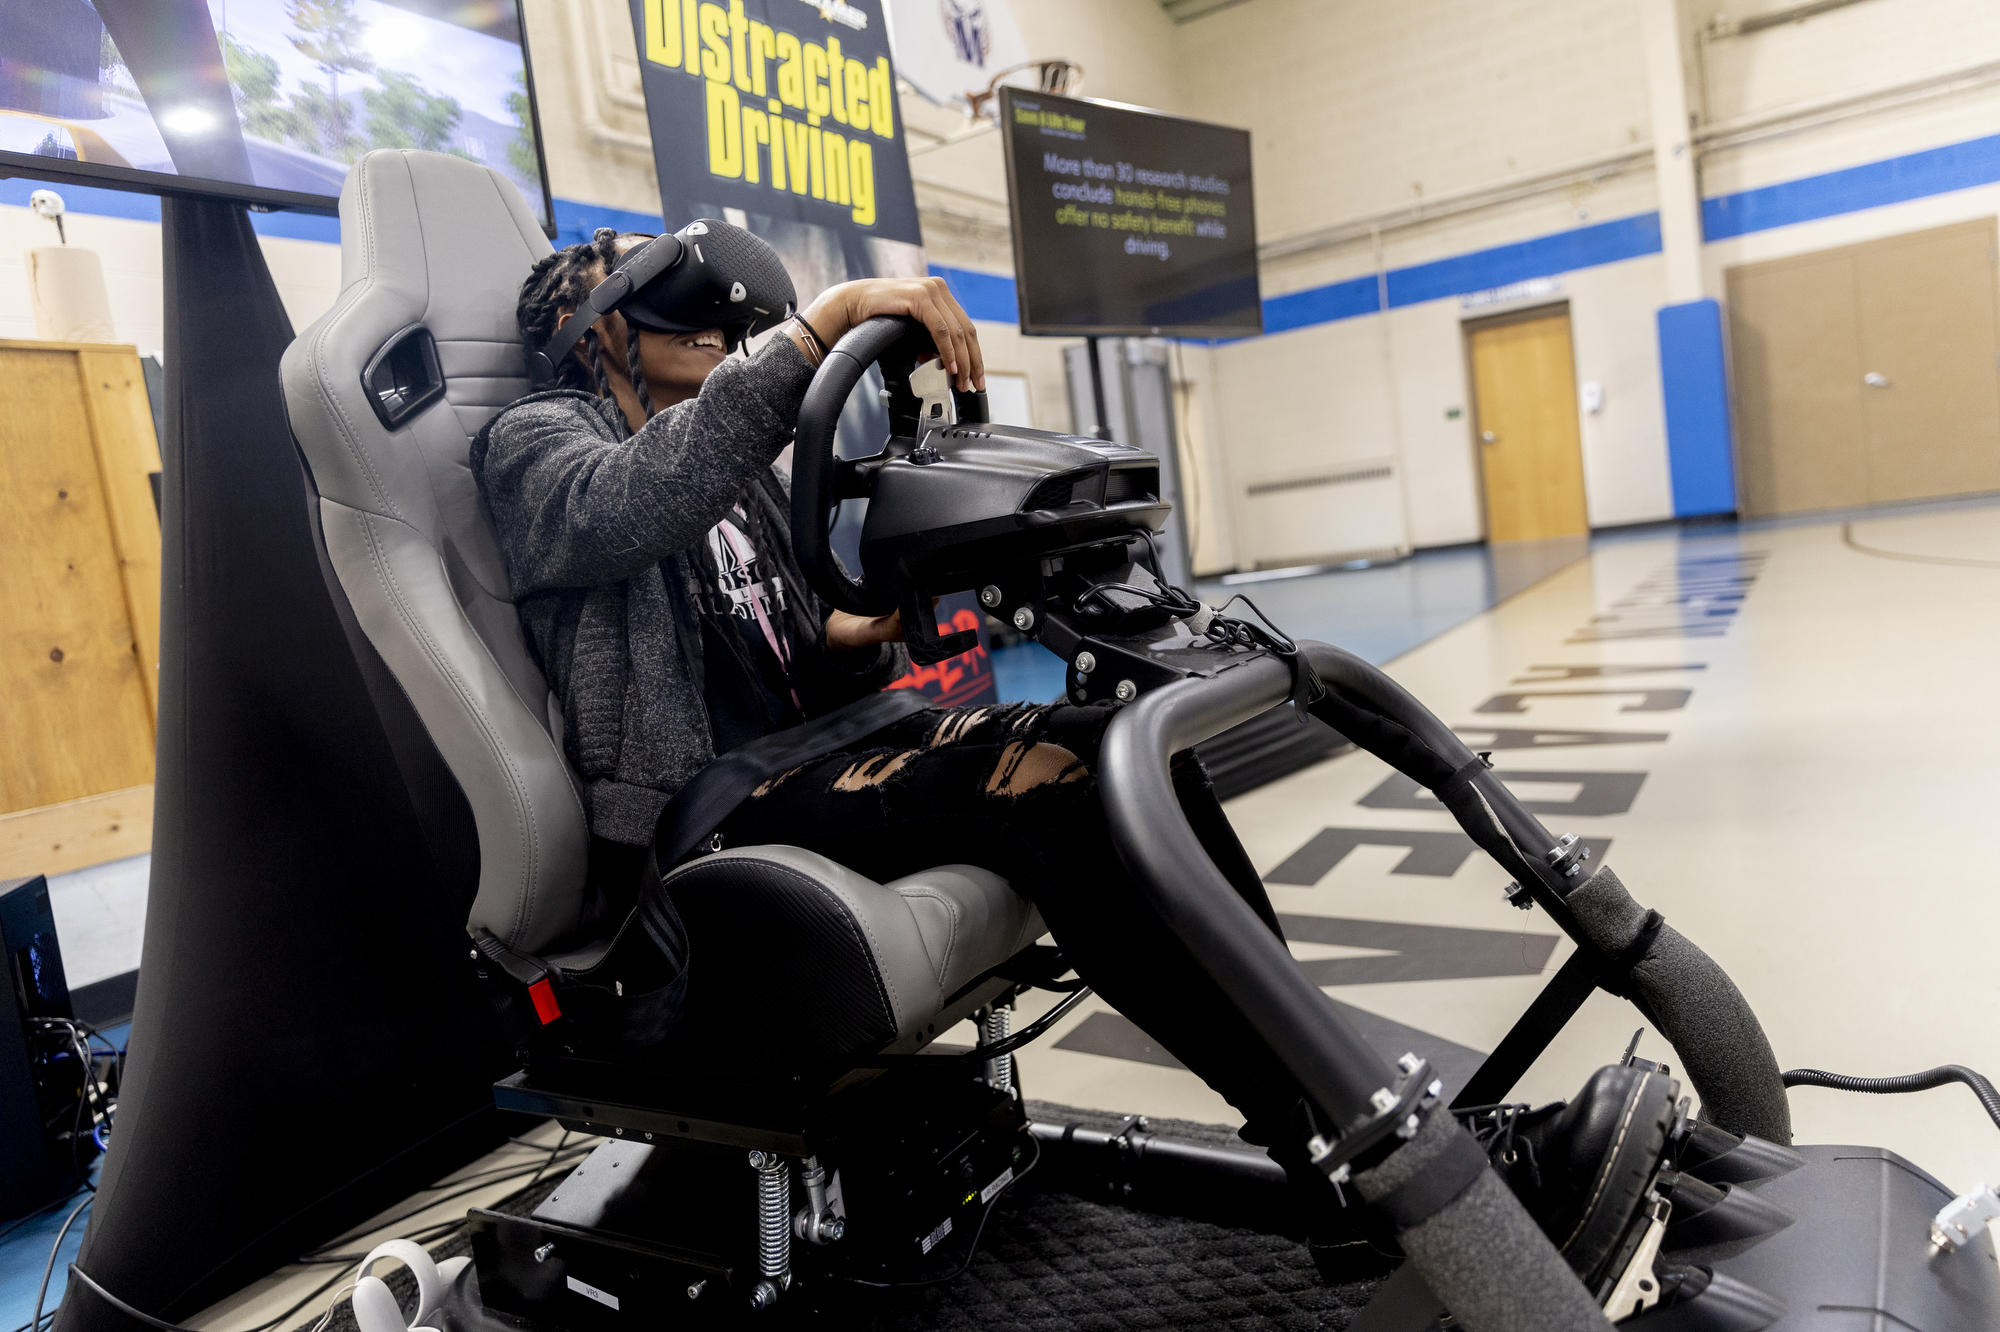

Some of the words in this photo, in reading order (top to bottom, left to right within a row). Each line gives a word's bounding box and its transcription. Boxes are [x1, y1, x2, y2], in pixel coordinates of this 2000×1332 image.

[644, 0, 895, 139] Distracted
[705, 79, 876, 226] Driving
[1043, 152, 1082, 176] More
[1082, 156, 1114, 180] than
[1115, 162, 1134, 182] 30
[1135, 167, 1186, 189] research
[1188, 173, 1230, 195] studies
[1052, 181, 1114, 205] conclude
[1183, 195, 1227, 217] phones
[1055, 204, 1090, 227] offer
[1090, 211, 1110, 229] no
[1111, 210, 1149, 236] safety
[1151, 213, 1195, 236] benefit
[1195, 219, 1227, 239] while
[1124, 235, 1172, 261] driving.
[585, 1286, 599, 1299] VR3
